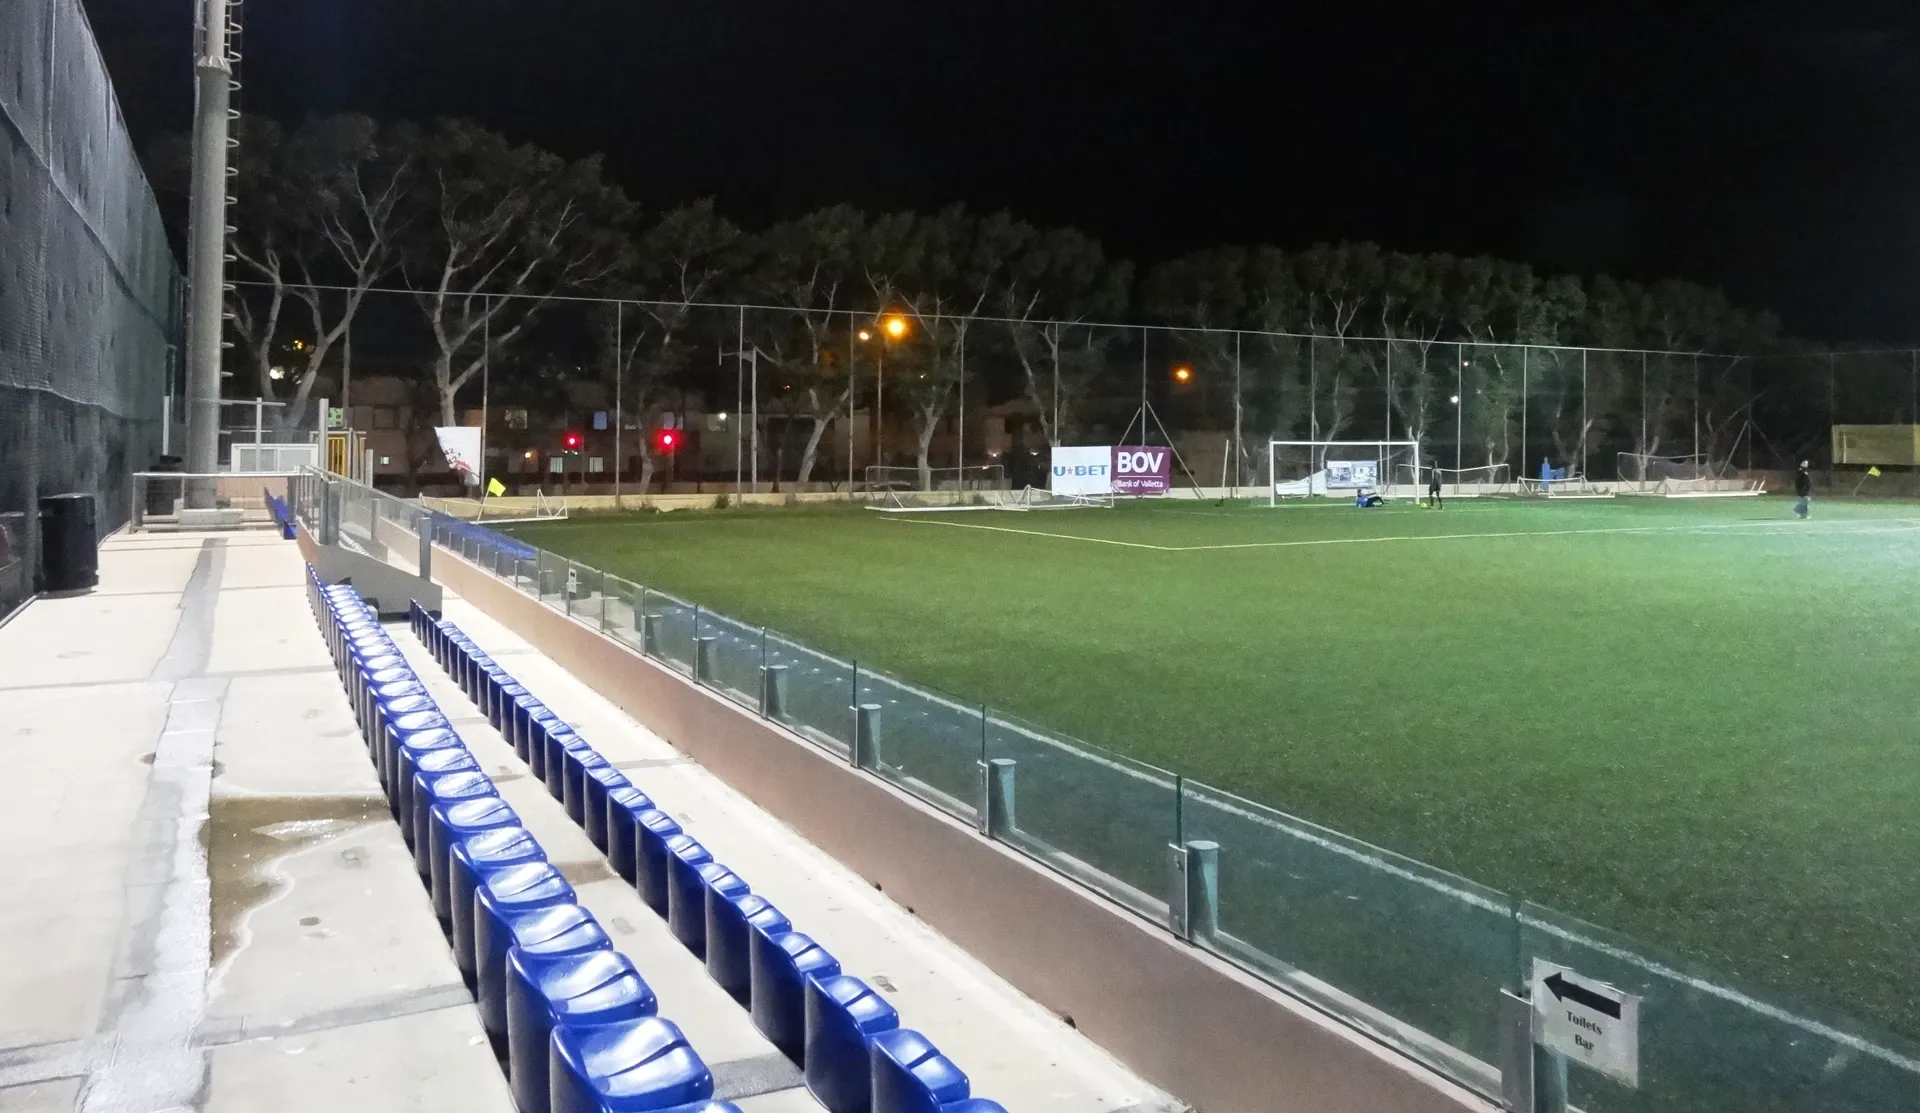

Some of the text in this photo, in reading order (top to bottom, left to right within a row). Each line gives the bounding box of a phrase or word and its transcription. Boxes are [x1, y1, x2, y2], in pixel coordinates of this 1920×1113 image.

[1117, 452, 1164, 473] BOV
[1117, 480, 1163, 488] Bank of Valletta
[1567, 1010, 1603, 1035] Toilets
[1574, 1034, 1594, 1051] Bar
